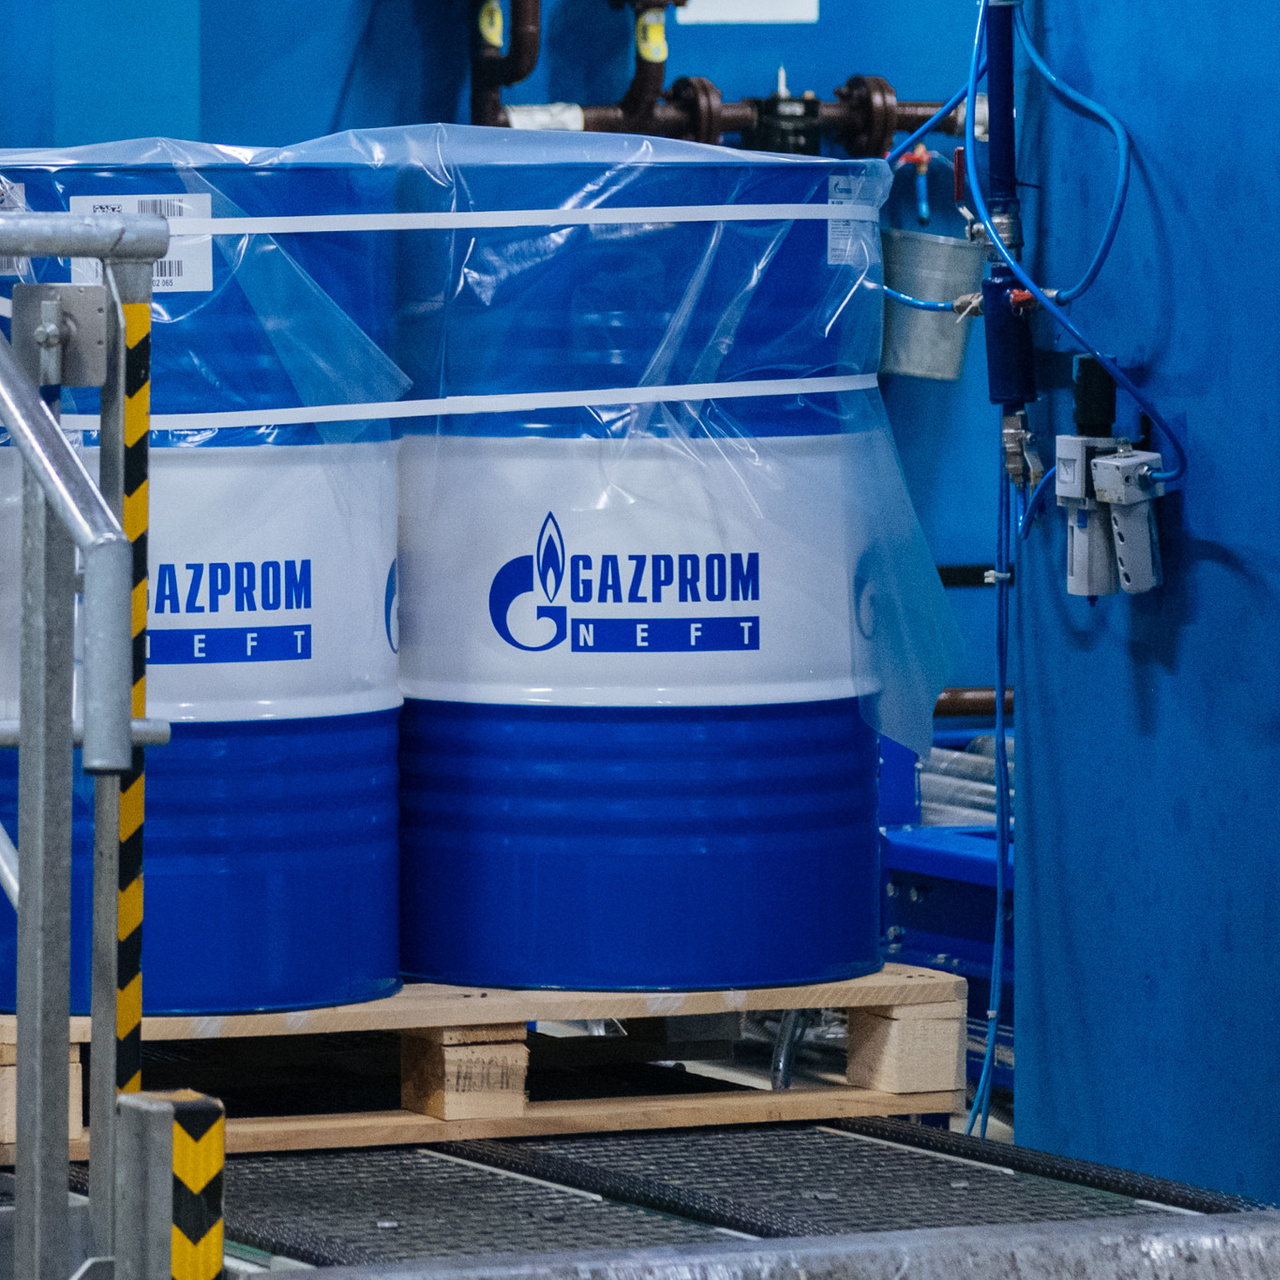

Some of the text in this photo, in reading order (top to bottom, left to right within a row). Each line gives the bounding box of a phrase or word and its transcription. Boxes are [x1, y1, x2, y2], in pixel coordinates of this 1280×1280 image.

[147, 559, 312, 614] AZPROM
[570, 552, 760, 603] GAZPROM
[146, 631, 305, 658] EFT
[579, 622, 753, 647] NEFT
